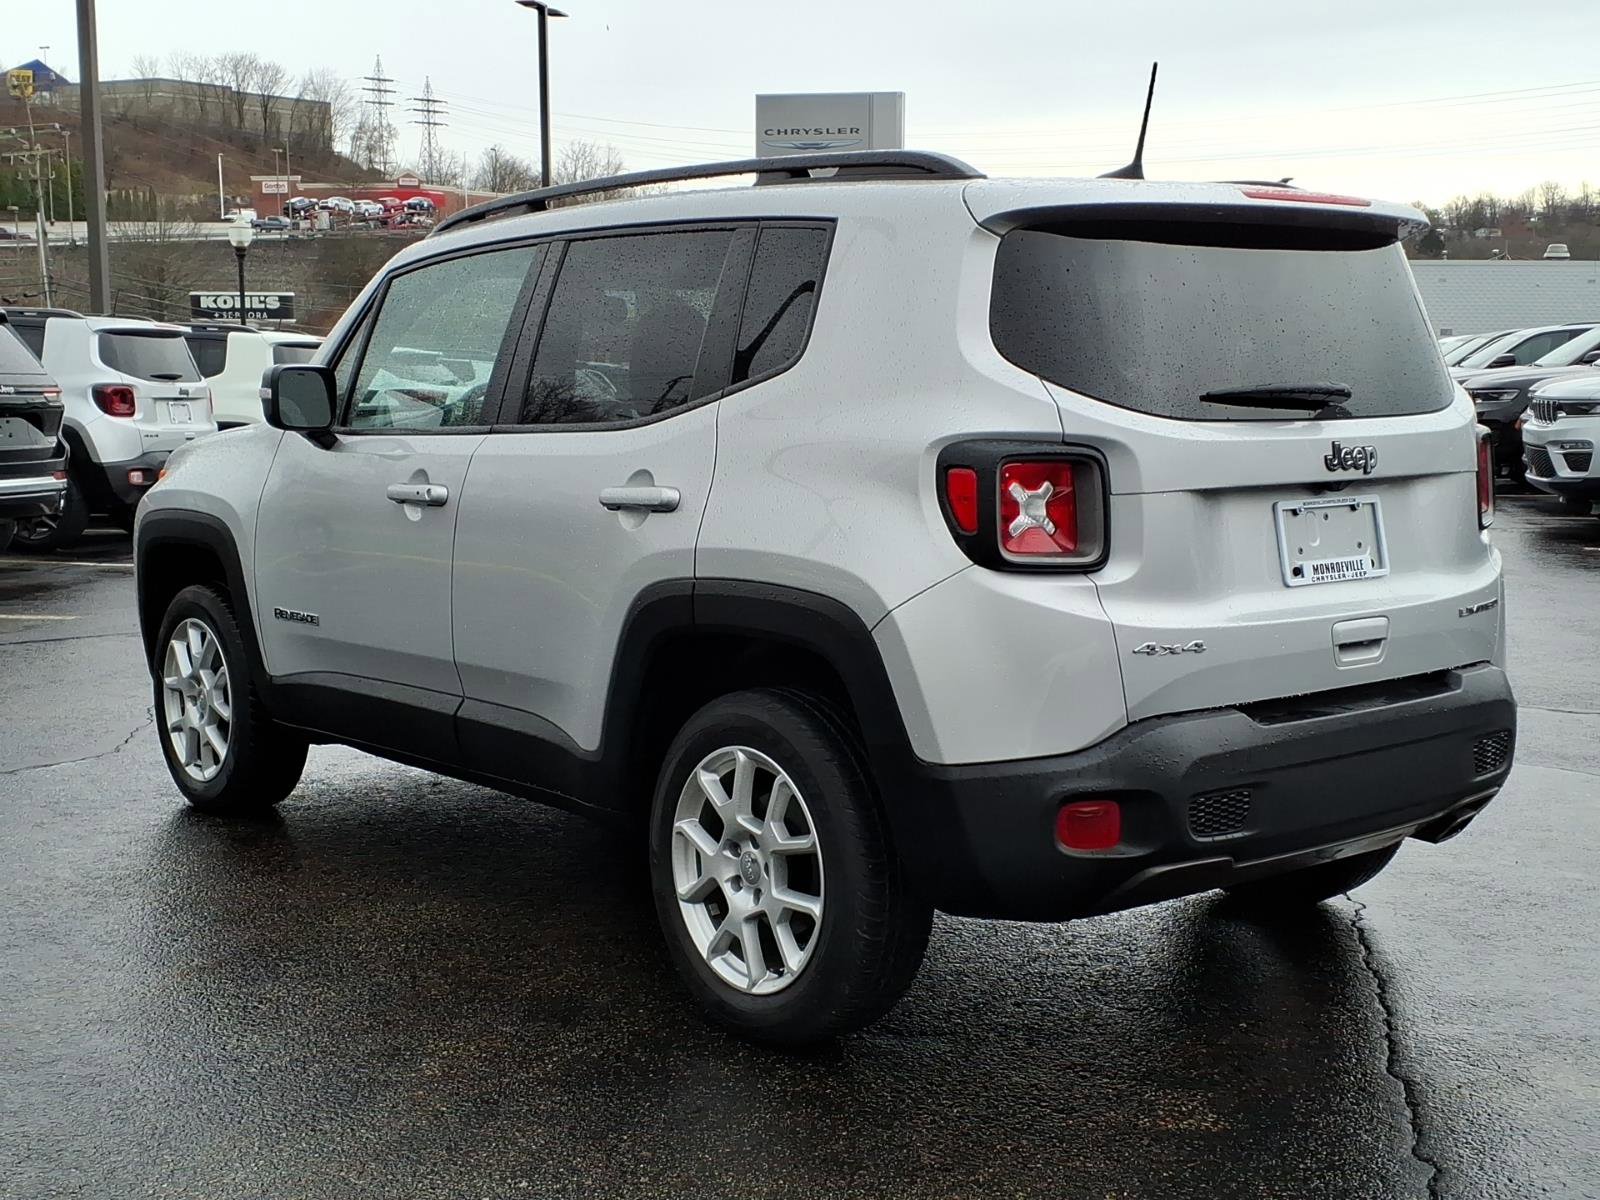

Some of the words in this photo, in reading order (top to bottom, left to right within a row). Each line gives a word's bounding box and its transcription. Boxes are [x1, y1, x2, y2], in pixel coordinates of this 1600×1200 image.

[764, 127, 860, 136] CHRYSLER
[200, 295, 280, 309] KOHL'S
[222, 311, 268, 319] SEPORA
[1325, 441, 1377, 474] Jeep
[1312, 559, 1364, 575] MONROEVILLE
[1132, 640, 1206, 656] 4x4
